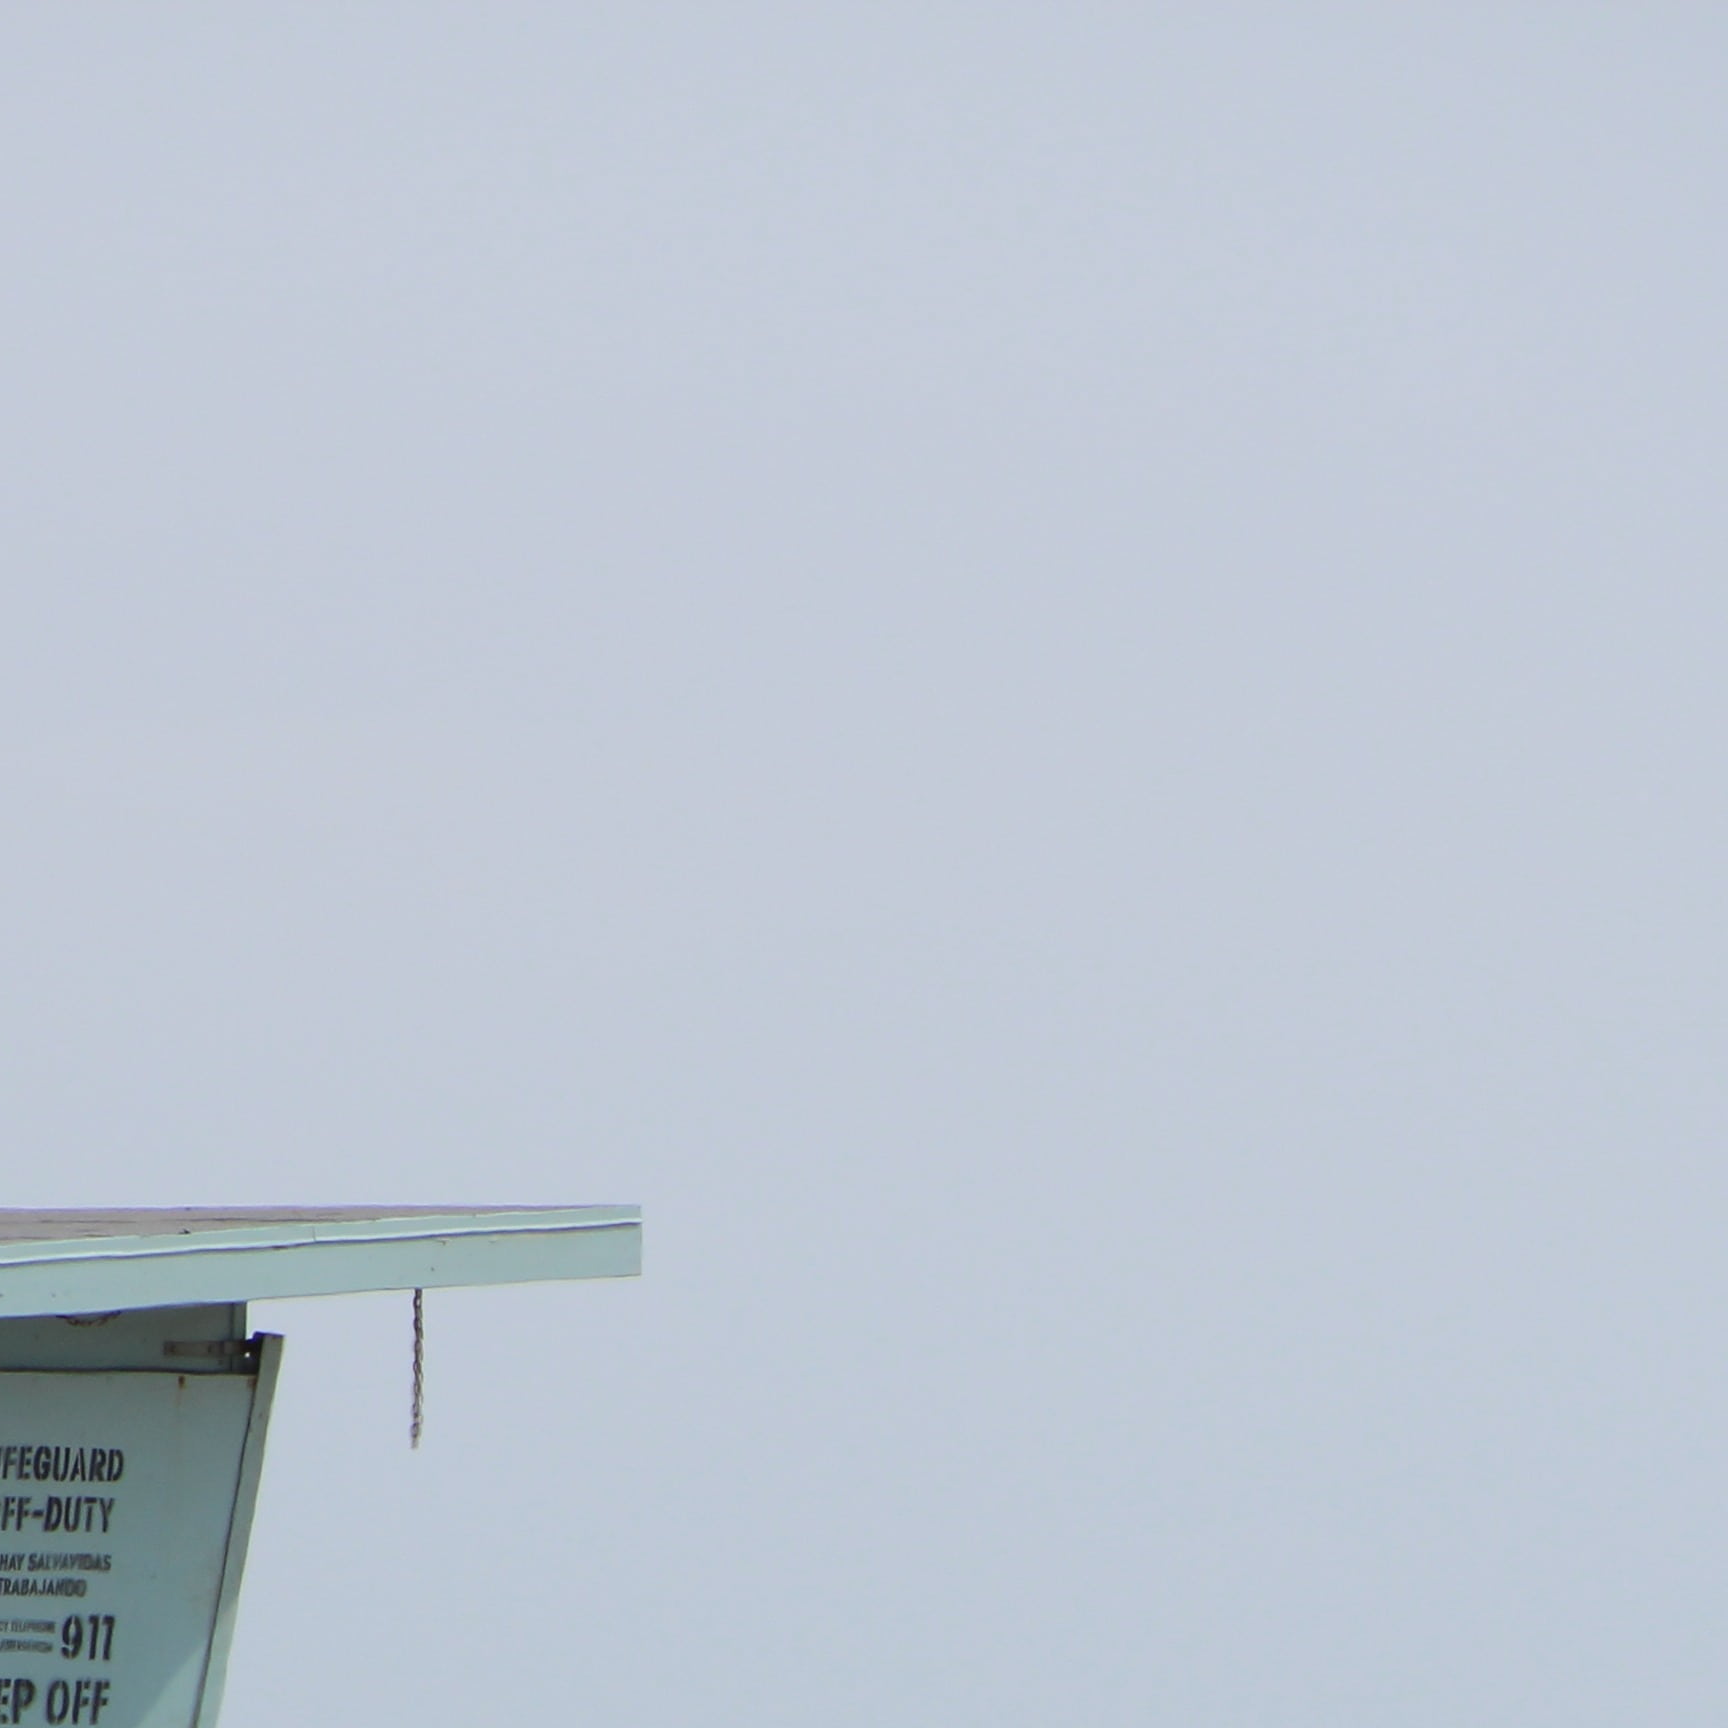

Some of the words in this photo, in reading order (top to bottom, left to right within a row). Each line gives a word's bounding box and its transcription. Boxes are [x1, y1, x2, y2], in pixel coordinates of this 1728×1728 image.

[0, 1554, 25, 1571] HAY
[61, 1614, 115, 1662] 911
[45, 1679, 110, 1726] OFF
